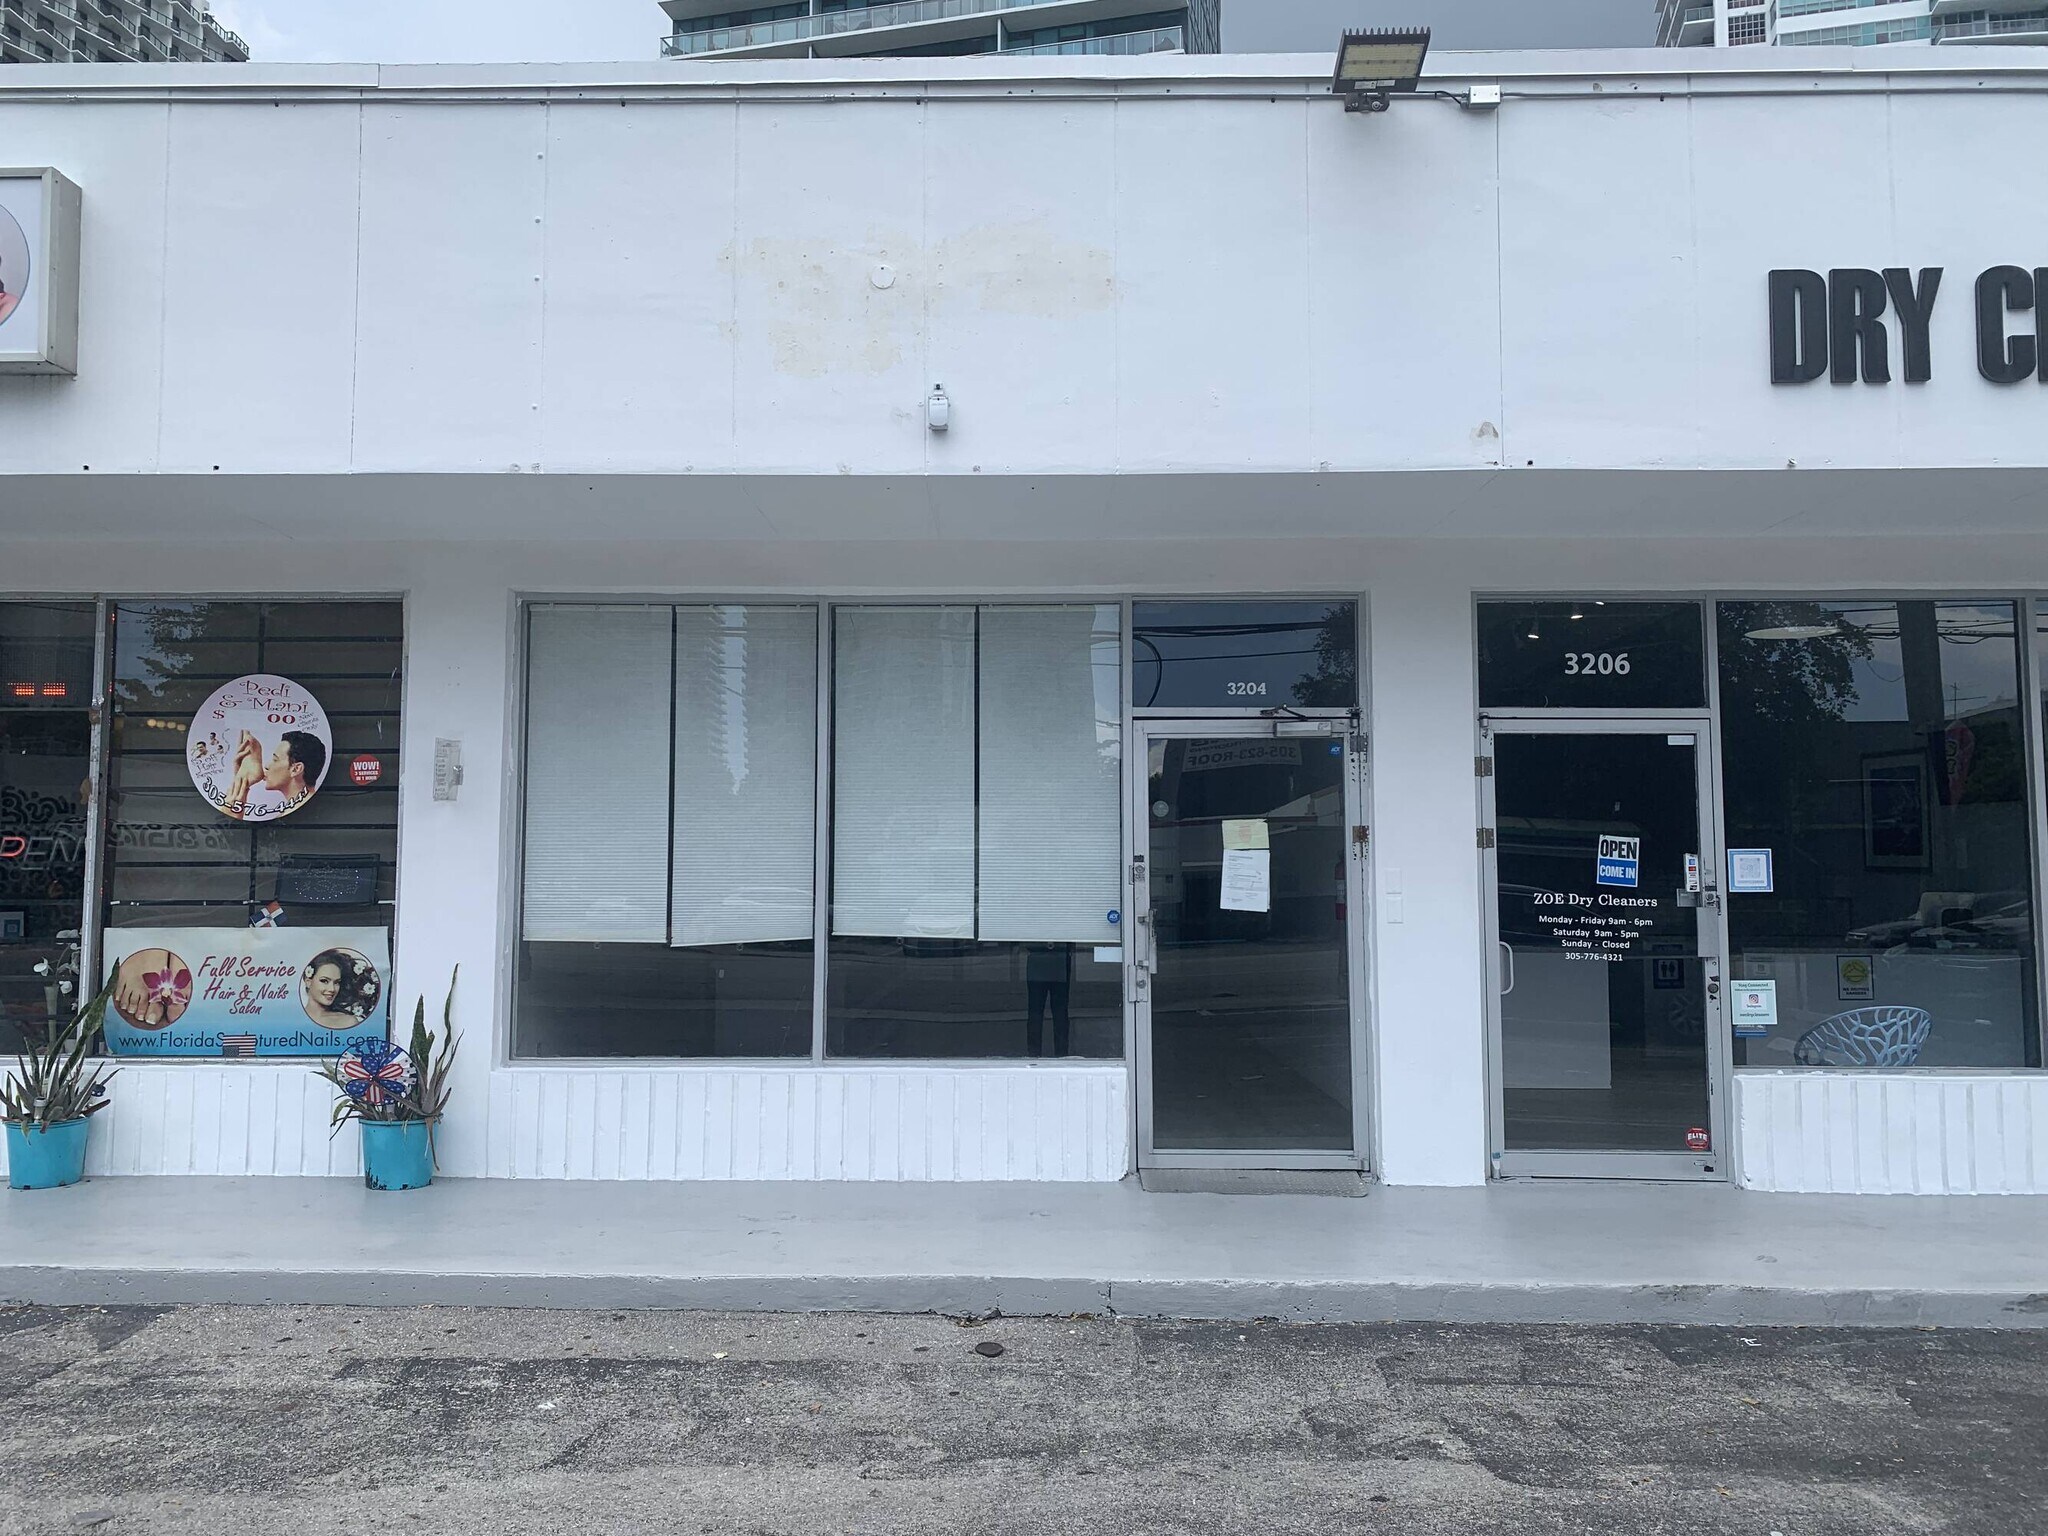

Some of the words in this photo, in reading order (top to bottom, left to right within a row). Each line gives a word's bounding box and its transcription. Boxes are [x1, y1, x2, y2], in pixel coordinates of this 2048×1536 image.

[1768, 267, 1944, 384] DRY
[1564, 652, 1631, 675] 3206
[239, 680, 292, 698] Pedi
[1227, 682, 1267, 695] 3204
[246, 697, 309, 714] Mani
[353, 761, 380, 771] WOW!
[1600, 839, 1638, 859] OPEN
[1600, 865, 1625, 878] COME
[1626, 867, 1636, 879] IN
[1533, 893, 1564, 905] ZOE
[1568, 893, 1594, 907] Dry
[1598, 894, 1658, 907] Cleaners
[1538, 915, 1573, 925] Monday
[1580, 916, 1607, 926] Friday
[1608, 917, 1627, 925] 9am
[1634, 918, 1653, 927] 6pm
[1553, 928, 1590, 938] Saturday
[1594, 929, 1613, 937] 9am
[1620, 930, 1639, 939] 5pm
[1561, 939, 1592, 949] Sunday
[1602, 941, 1630, 949] Closed
[1565, 952, 1623, 962] 305-776-4321
[197, 955, 237, 978] Full
[235, 956, 297, 977] Service
[203, 977, 236, 1000] Hair
[239, 983, 253, 1000] &
[256, 983, 290, 1000] Nails
[229, 997, 263, 1015] Salon
[118, 1030, 379, 1048] www.FloridaSturedNails.com
[1687, 1132, 1708, 1142] ELITE
